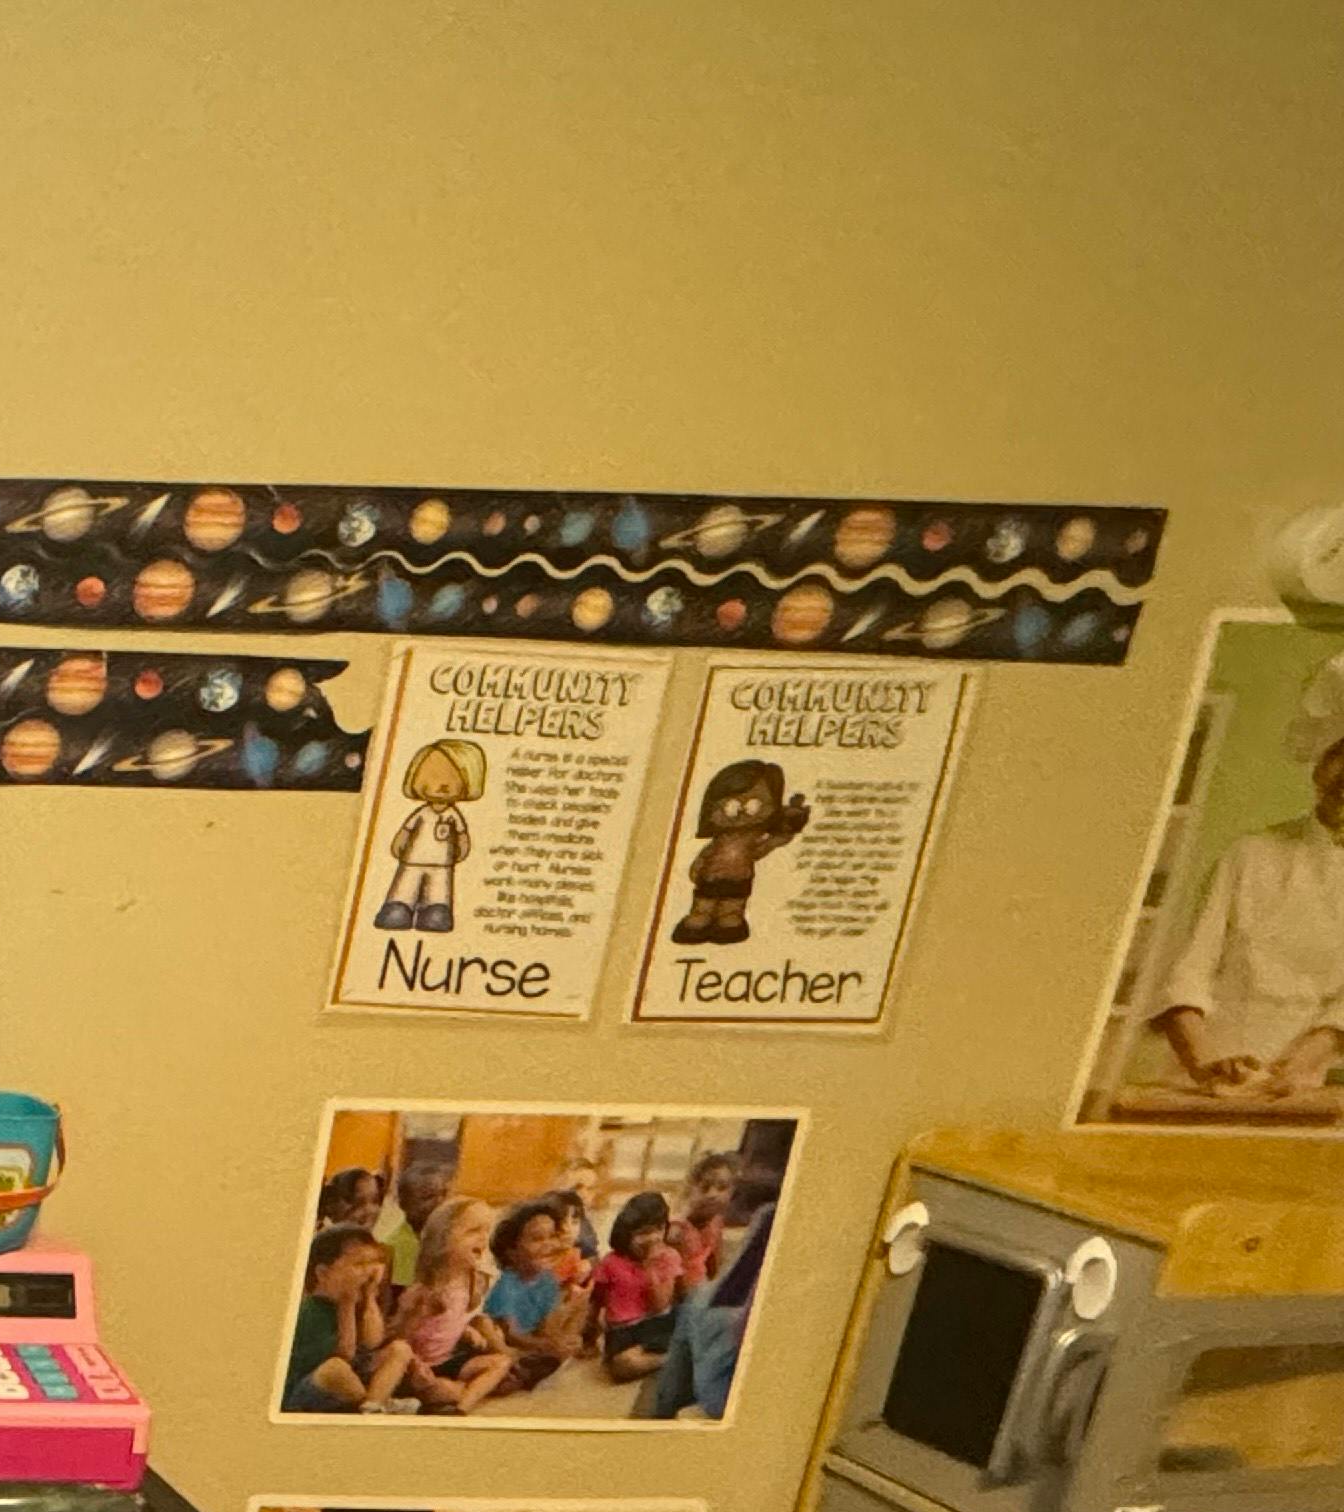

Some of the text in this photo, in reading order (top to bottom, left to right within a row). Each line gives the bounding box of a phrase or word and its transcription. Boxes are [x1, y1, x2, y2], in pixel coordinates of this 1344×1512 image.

[429, 662, 643, 706] COMMUNITY
[729, 679, 936, 714] COMMUNITY
[446, 702, 606, 740] HELPERS
[746, 713, 906, 749] HELPERS
[377, 937, 550, 998] Nurse
[674, 958, 863, 1004] Teacher
